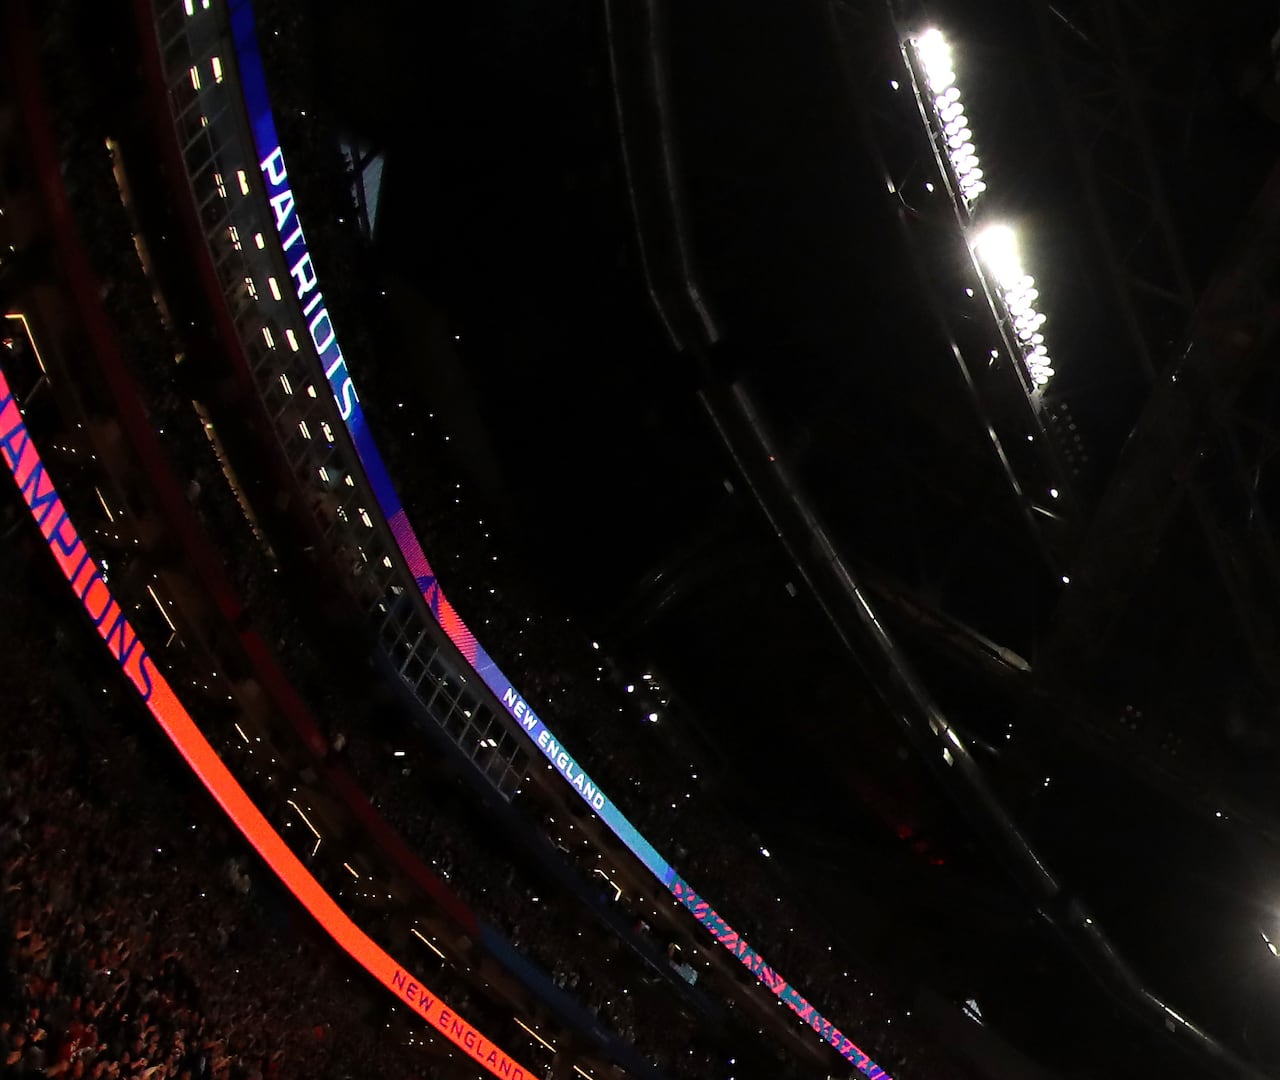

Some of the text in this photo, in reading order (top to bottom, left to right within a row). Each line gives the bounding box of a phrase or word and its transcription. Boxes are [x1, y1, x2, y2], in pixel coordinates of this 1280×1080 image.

[260, 146, 360, 422] PATRIOTS
[503, 687, 606, 810] NEW ENGLAND
[391, 970, 433, 1012] NEW
